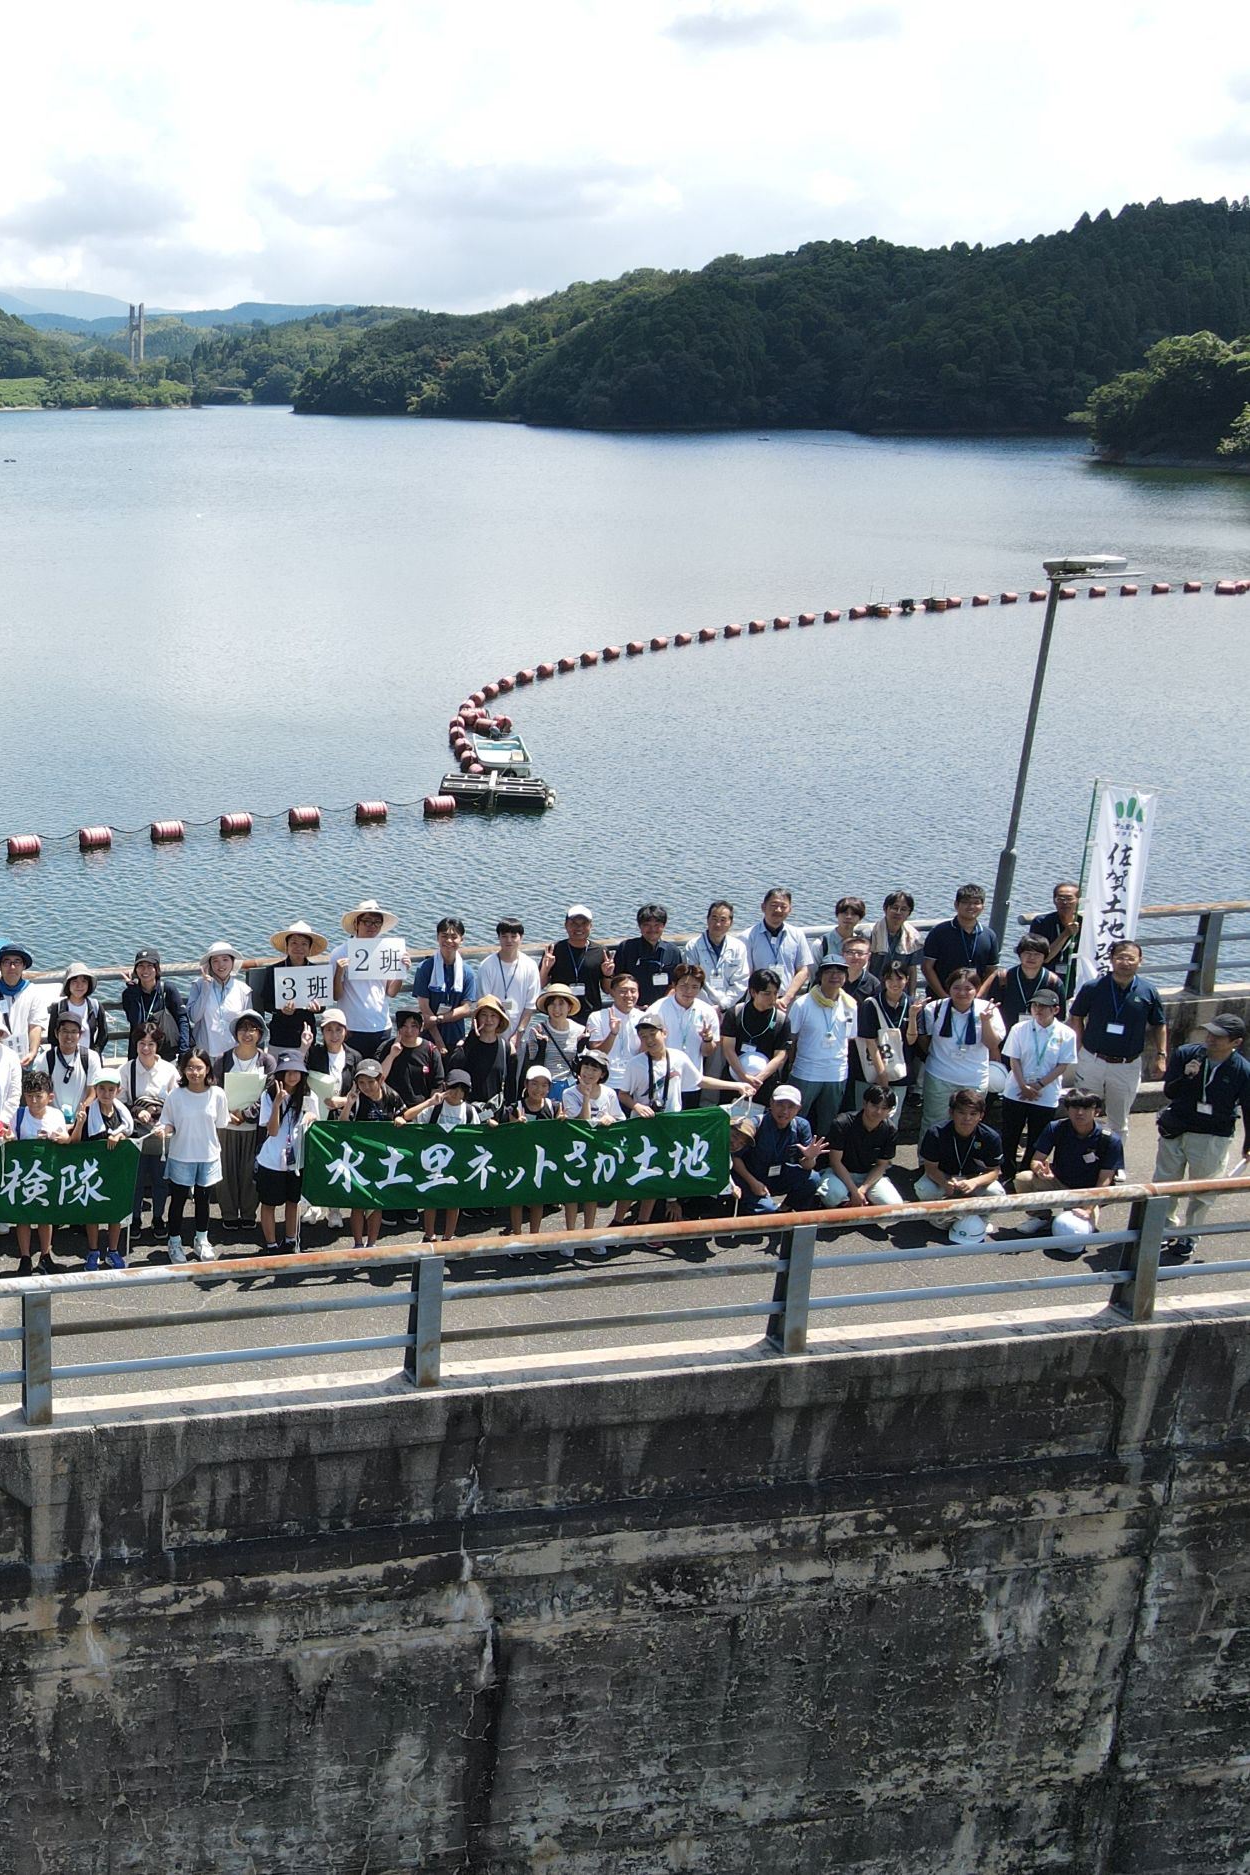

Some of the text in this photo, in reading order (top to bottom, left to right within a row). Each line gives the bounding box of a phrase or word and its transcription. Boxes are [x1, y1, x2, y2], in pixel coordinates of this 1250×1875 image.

[324, 1133, 711, 1194] 水土里ネットさが土地
